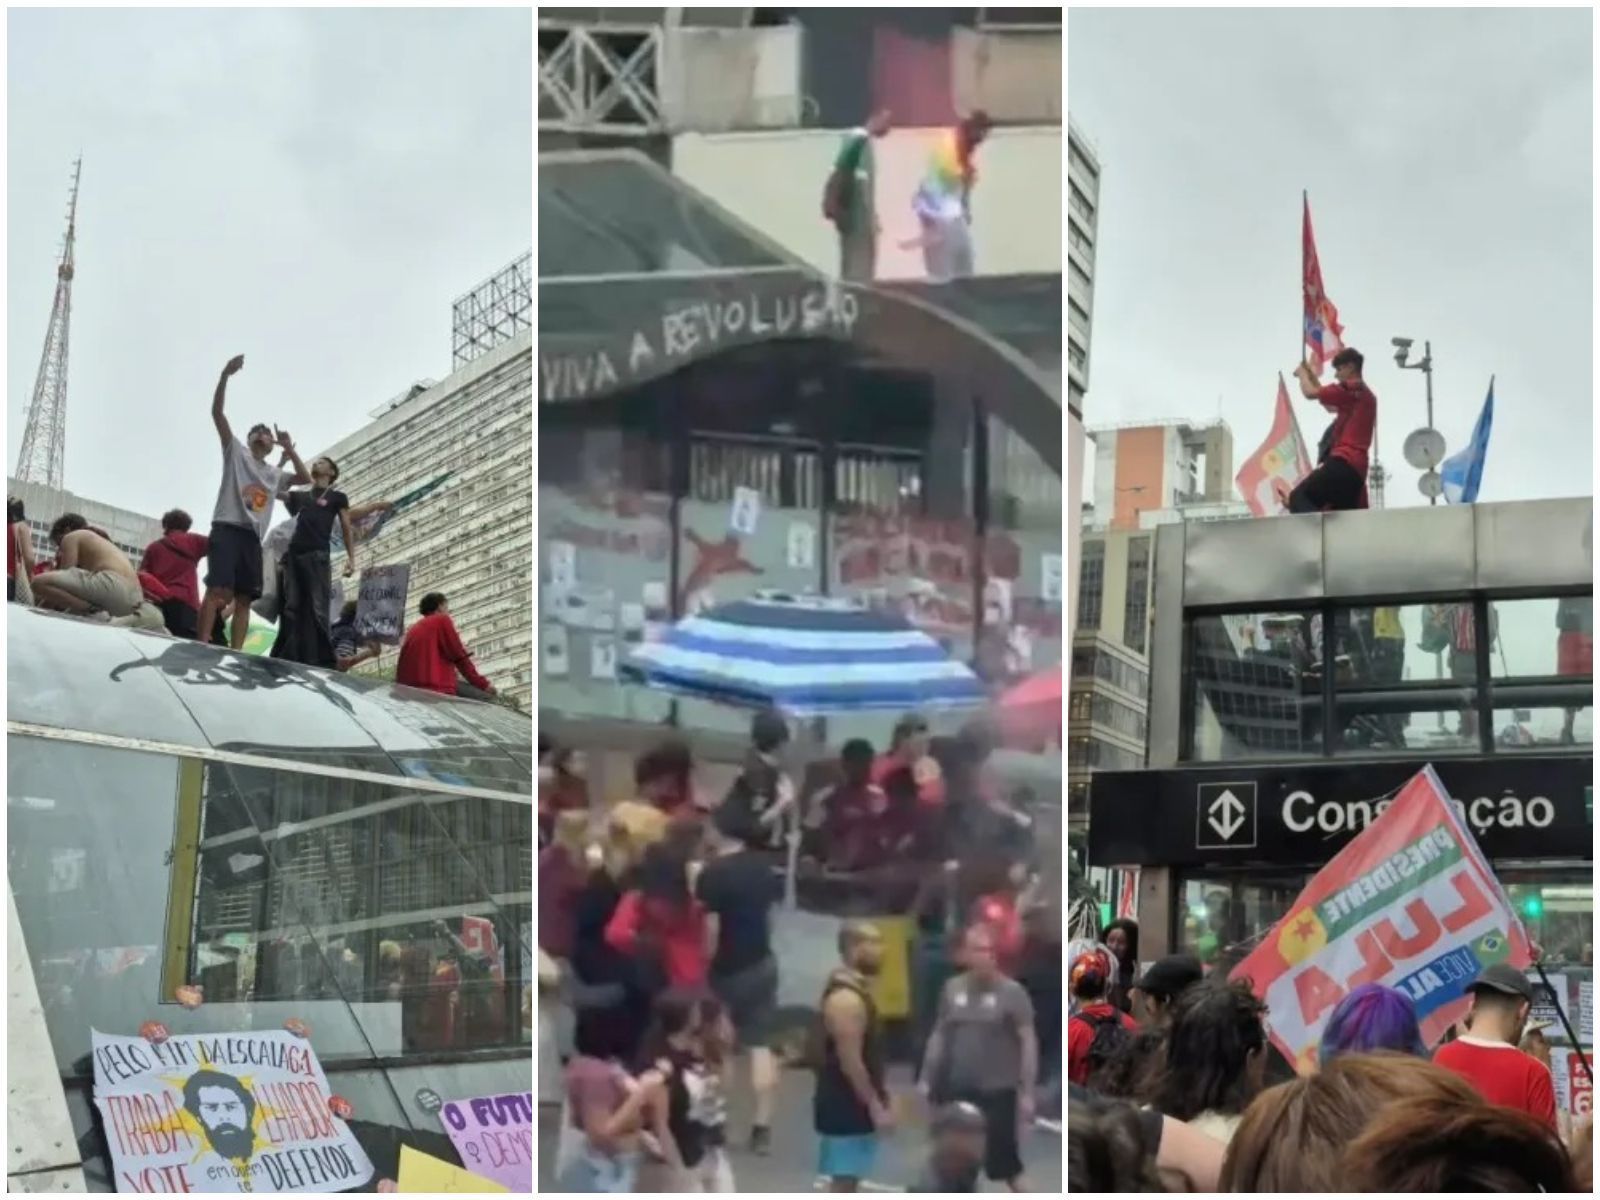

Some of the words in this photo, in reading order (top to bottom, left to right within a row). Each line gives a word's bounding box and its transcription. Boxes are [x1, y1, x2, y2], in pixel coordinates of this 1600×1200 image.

[541, 352, 618, 402] VIVA
[628, 329, 655, 372] A
[1282, 789, 1555, 835] Conção
[96, 1044, 152, 1085] PELO
[151, 1040, 200, 1067] FIM
[106, 1091, 193, 1156] TRABA
[444, 1103, 466, 1130] O
[123, 1163, 194, 1193] VOTE
[261, 1144, 360, 1191] DEFENDE
